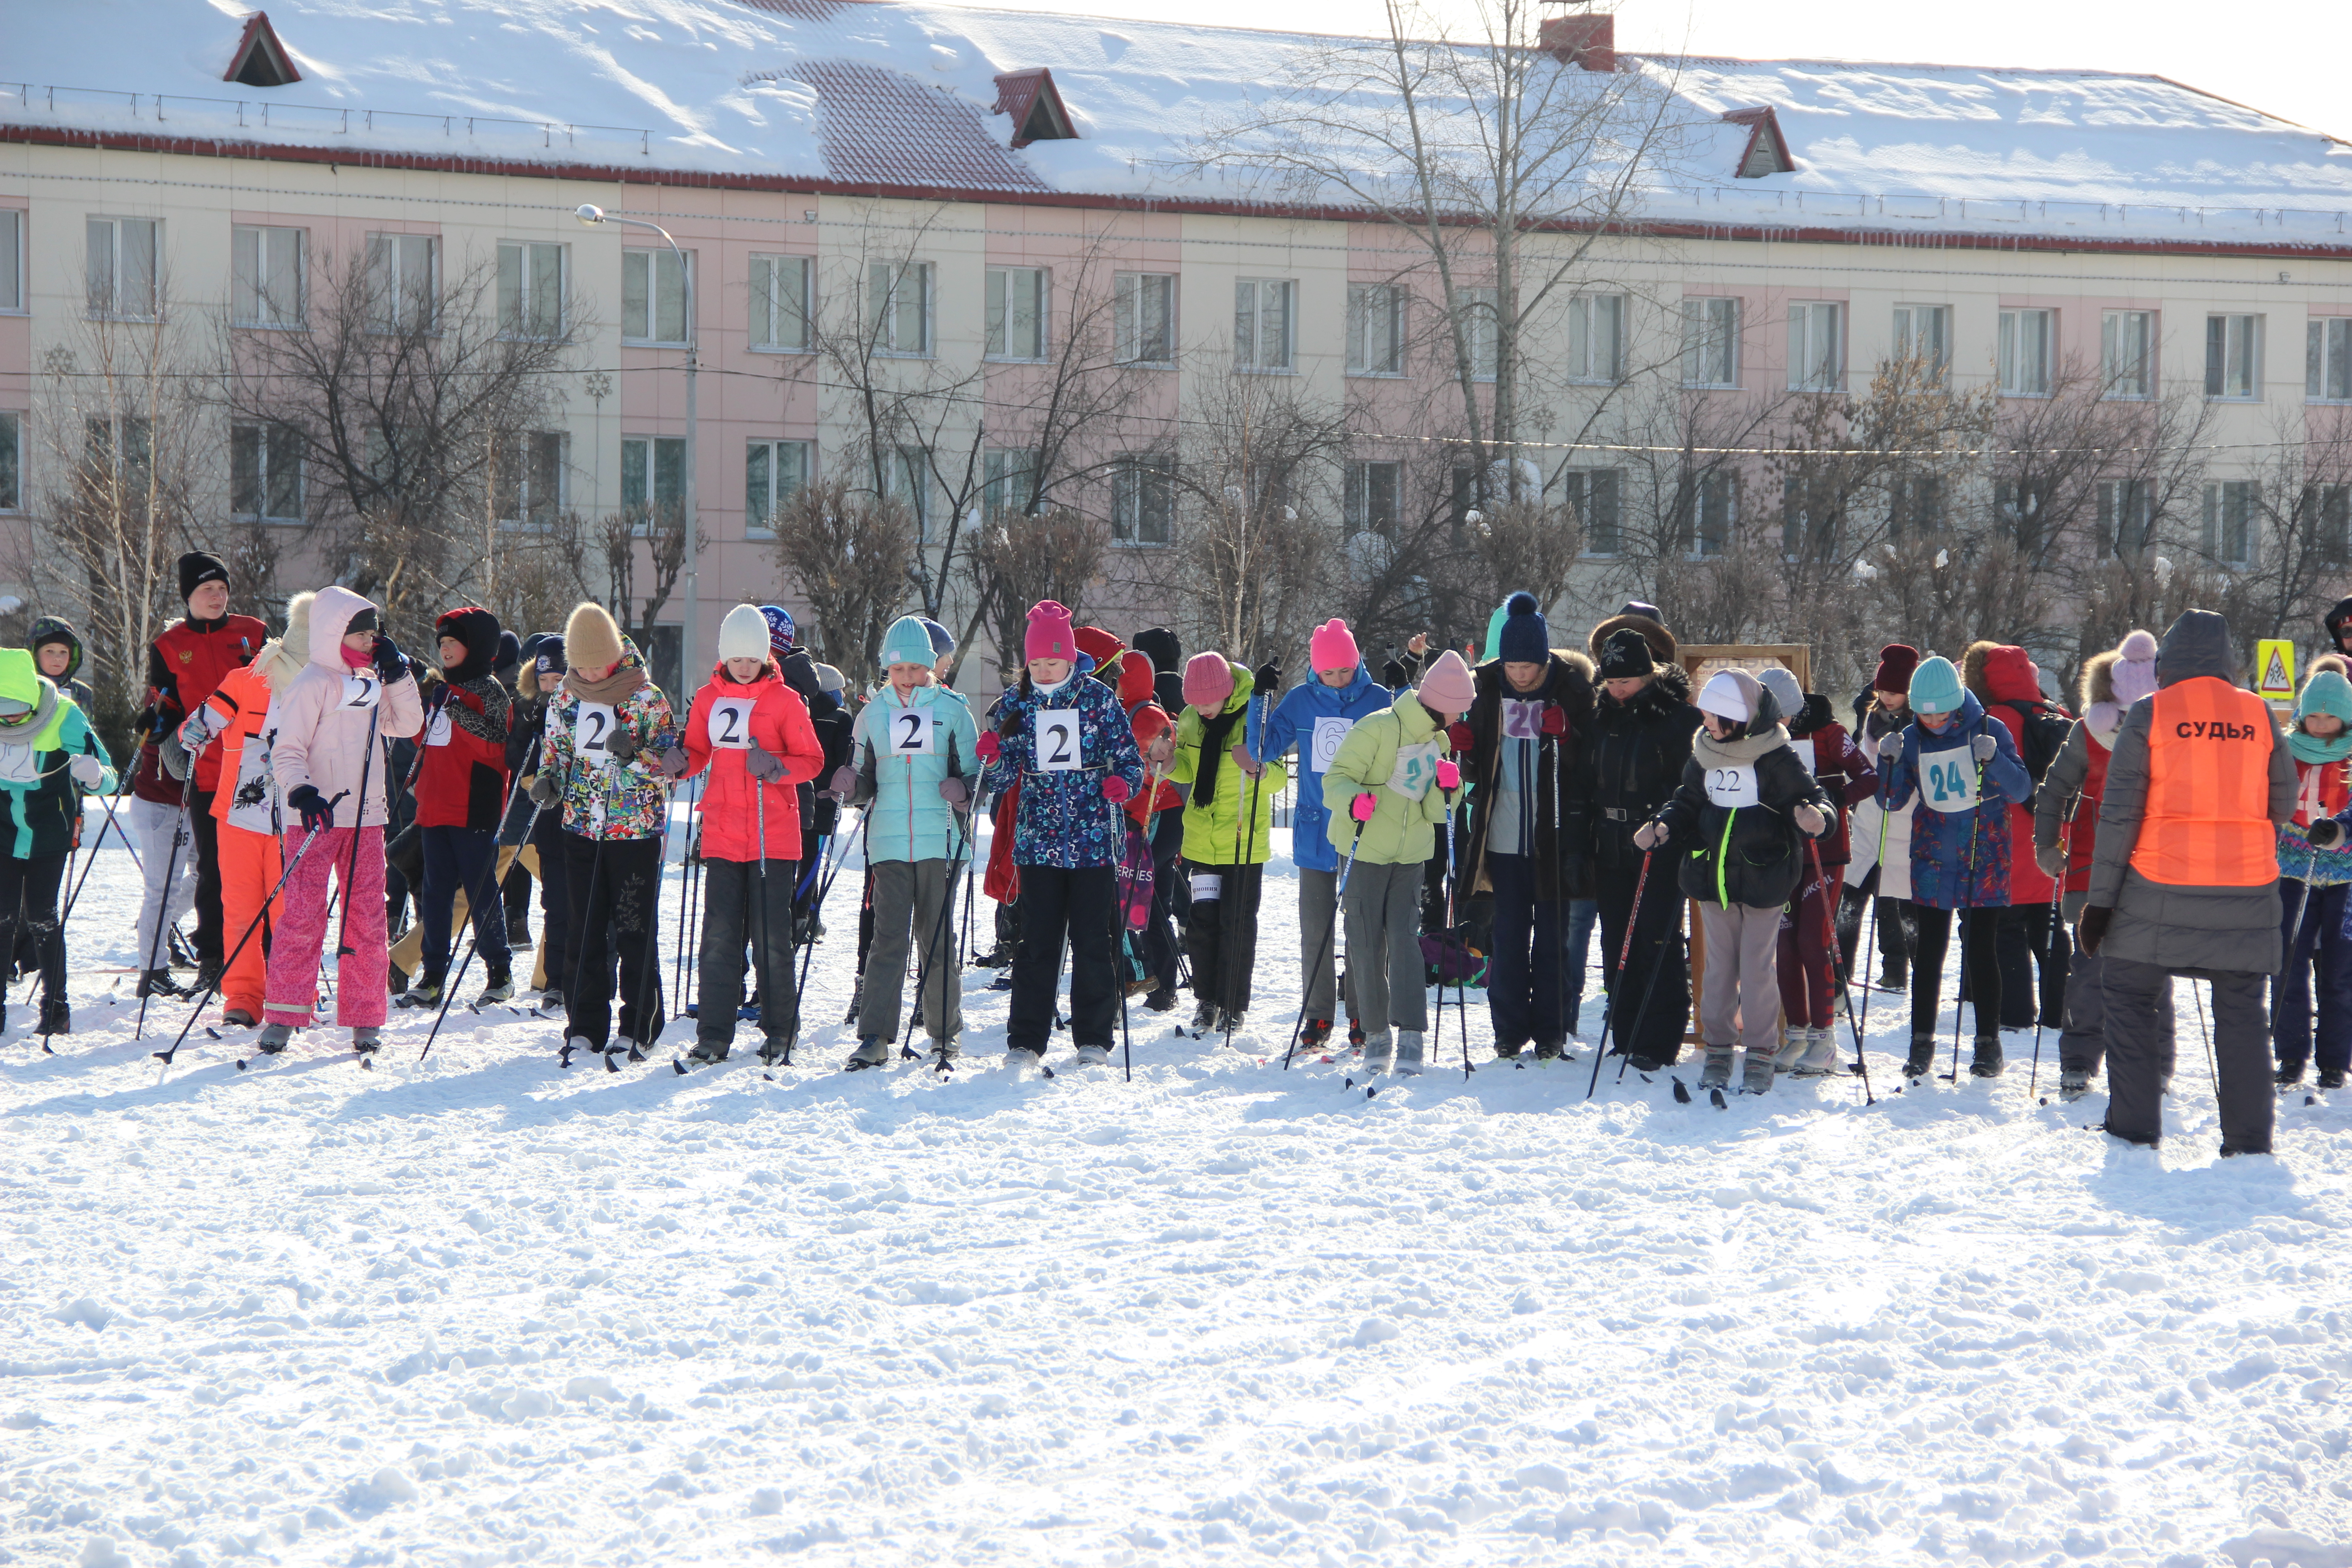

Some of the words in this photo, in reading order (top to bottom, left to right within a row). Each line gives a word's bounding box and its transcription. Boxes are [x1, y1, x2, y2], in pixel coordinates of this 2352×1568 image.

[347, 675, 372, 706] 2
[583, 711, 607, 750] 2
[718, 708, 740, 743] 2
[899, 715, 923, 749] 2
[1317, 721, 1346, 762] 6
[2177, 721, 2255, 741] СУДЬЯ
[1047, 724, 1071, 763] 2
[186, 751, 196, 777] NORDWAY
[1715, 769, 1741, 792] 22
[1930, 761, 1966, 801] 24
[835, 794, 844, 821] NORDWAY
[299, 832, 315, 856] NORDWAY
[1343, 850, 1355, 877] NORDWAY
[2305, 856, 2316, 892] NORDWAY
